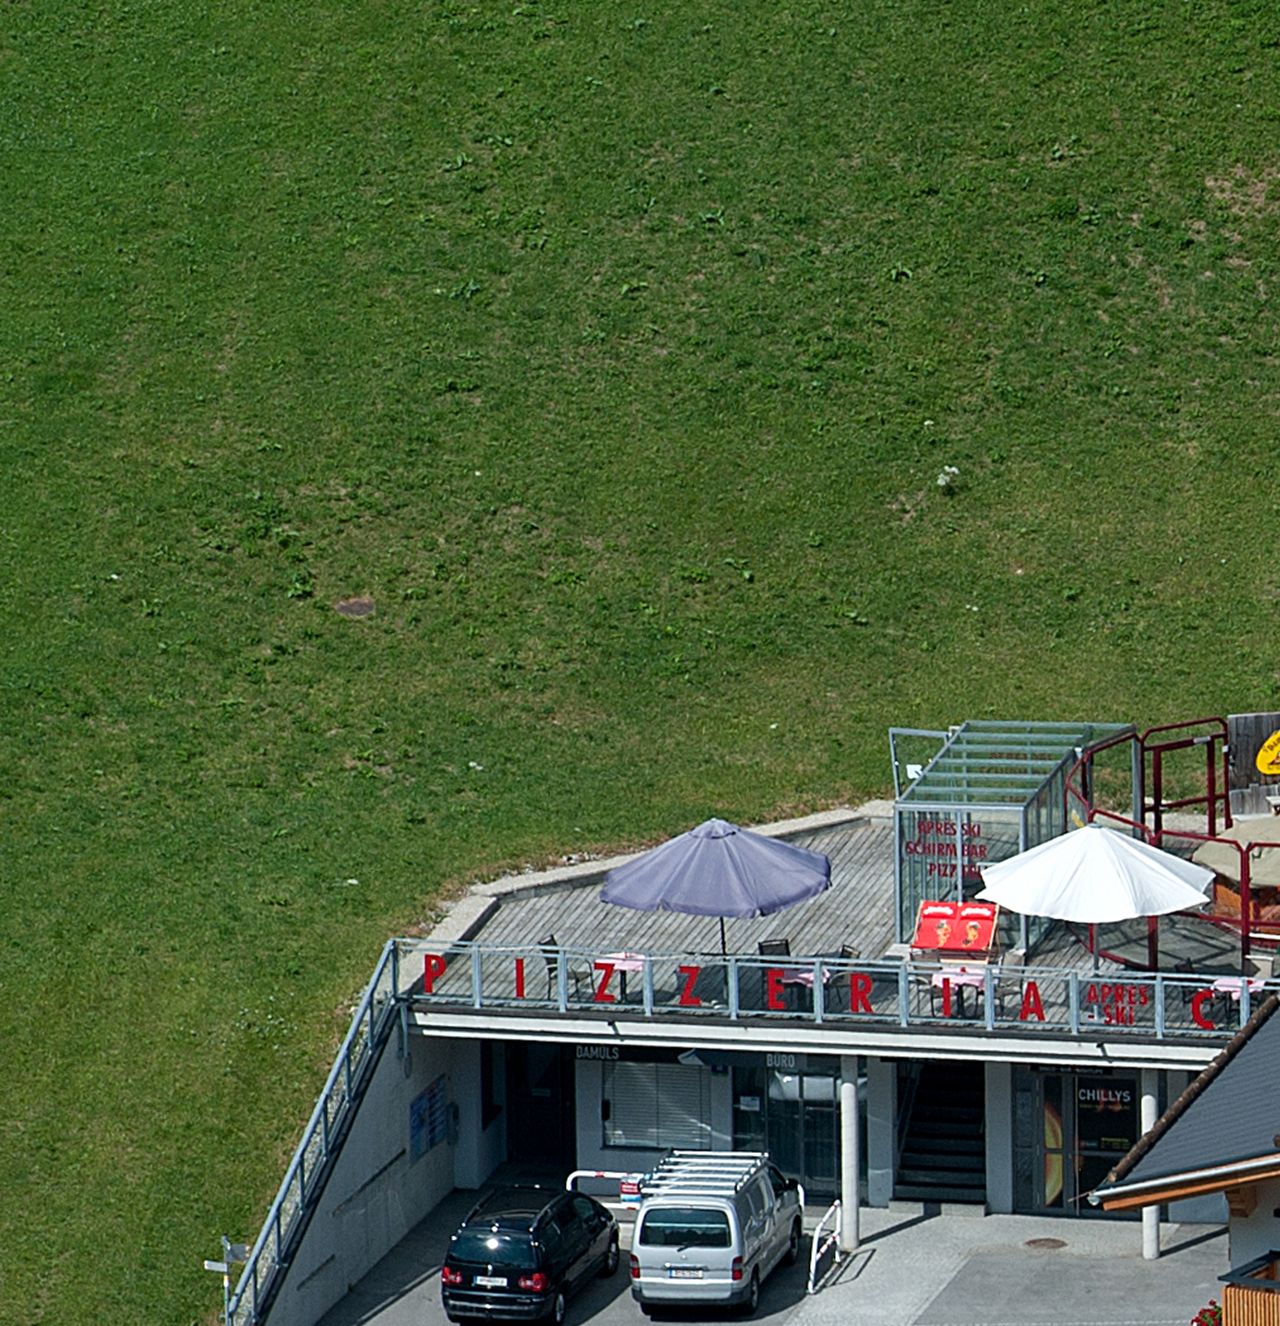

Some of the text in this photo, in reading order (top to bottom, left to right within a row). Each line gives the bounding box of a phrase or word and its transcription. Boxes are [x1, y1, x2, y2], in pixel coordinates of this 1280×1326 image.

[961, 822, 981, 838] SKI
[906, 840, 988, 858] SCHIRM BAR
[422, 953, 1046, 1022] PIZZERIA
[1078, 1088, 1132, 1103] CHILLYS
